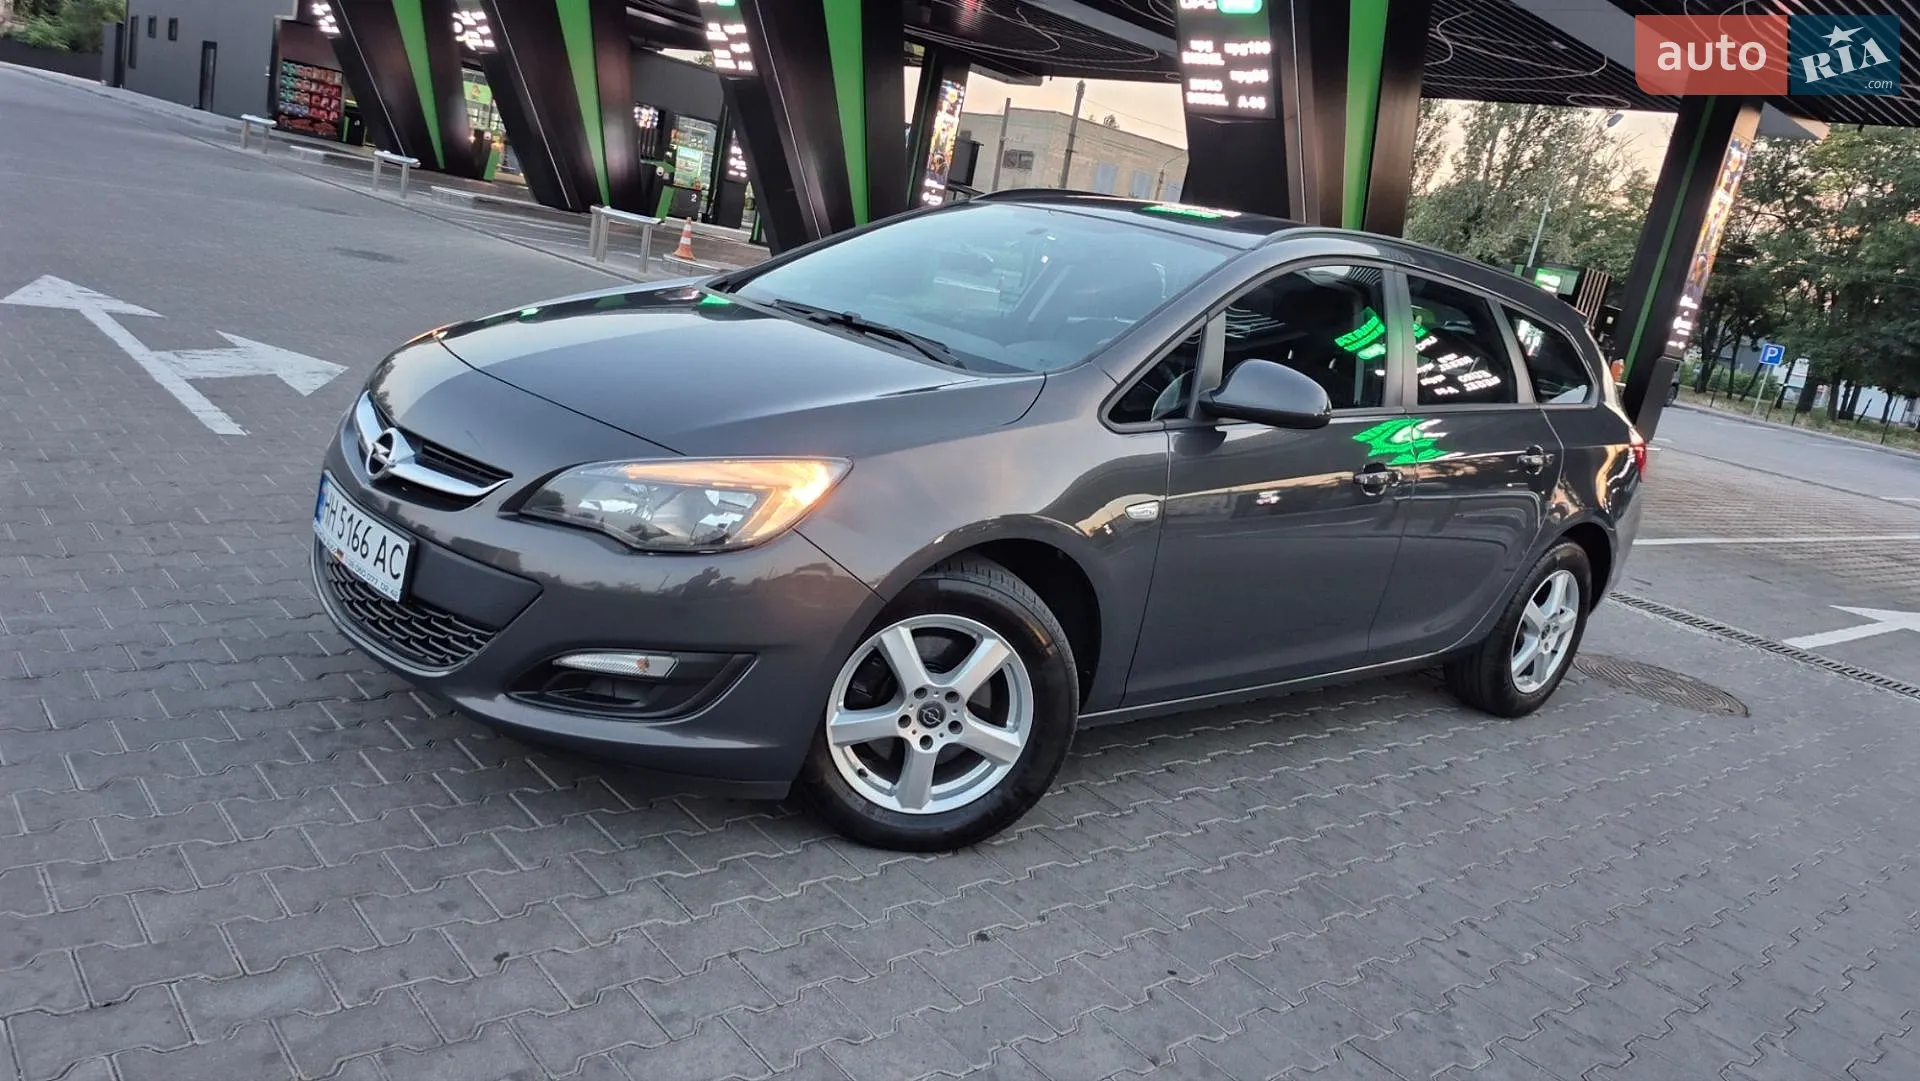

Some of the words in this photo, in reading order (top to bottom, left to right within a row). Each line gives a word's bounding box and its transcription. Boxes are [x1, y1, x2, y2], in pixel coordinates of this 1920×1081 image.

[691, 193, 698, 203] 2
[1765, 347, 1779, 362] P
[337, 505, 373, 560] 5166
[373, 534, 404, 581] AC
